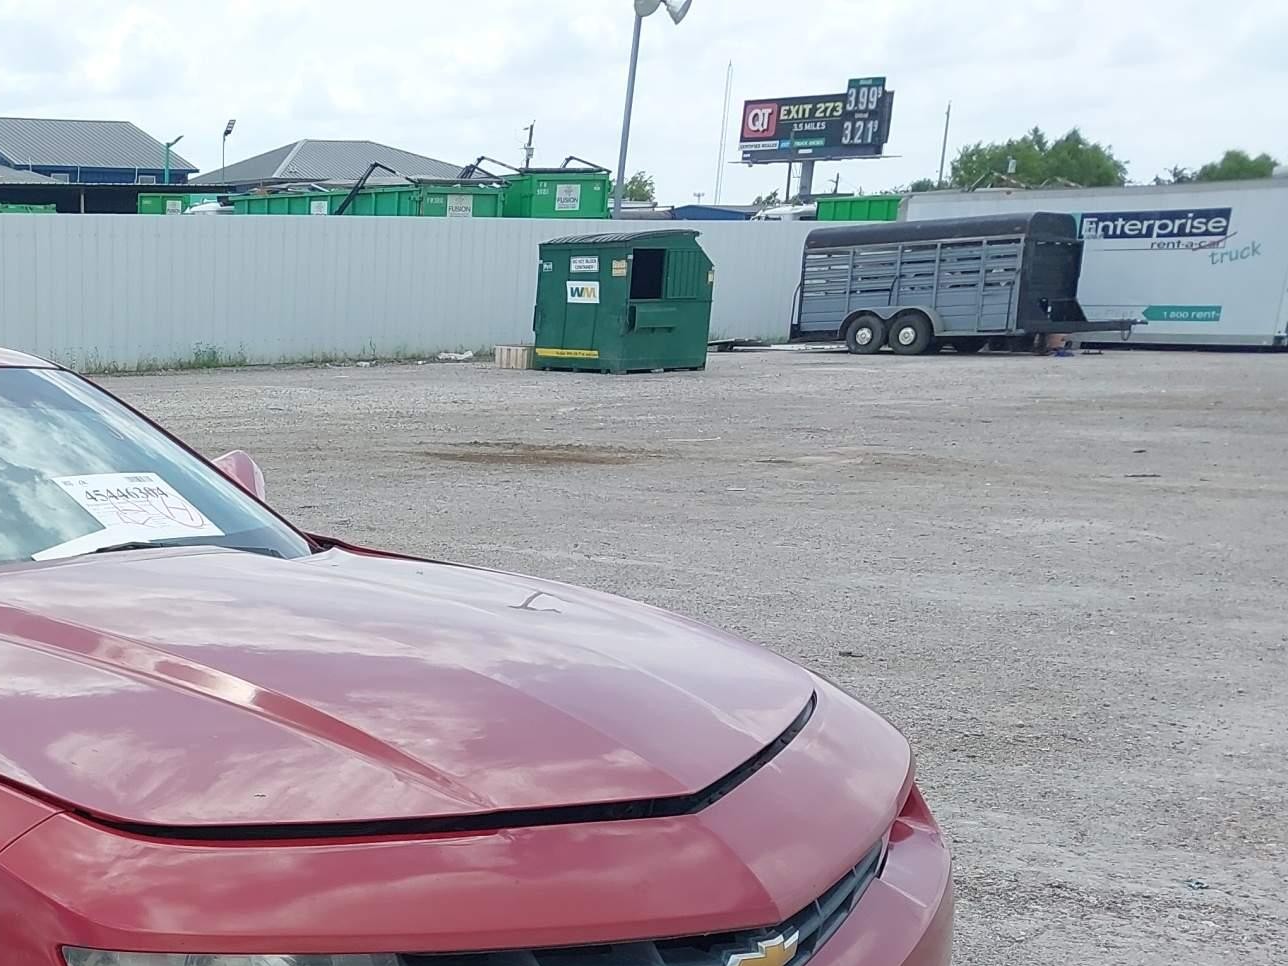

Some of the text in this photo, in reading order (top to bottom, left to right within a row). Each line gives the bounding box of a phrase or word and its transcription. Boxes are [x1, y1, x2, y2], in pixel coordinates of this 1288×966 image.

[747, 108, 772, 132] QT
[779, 102, 843, 120] EXIT 273
[804, 122, 826, 131] MILES
[1081, 213, 1228, 239] Enterprise
[1208, 240, 1262, 265] truck
[570, 286, 596, 298] WM
[1169, 311, 1189, 319] 800
